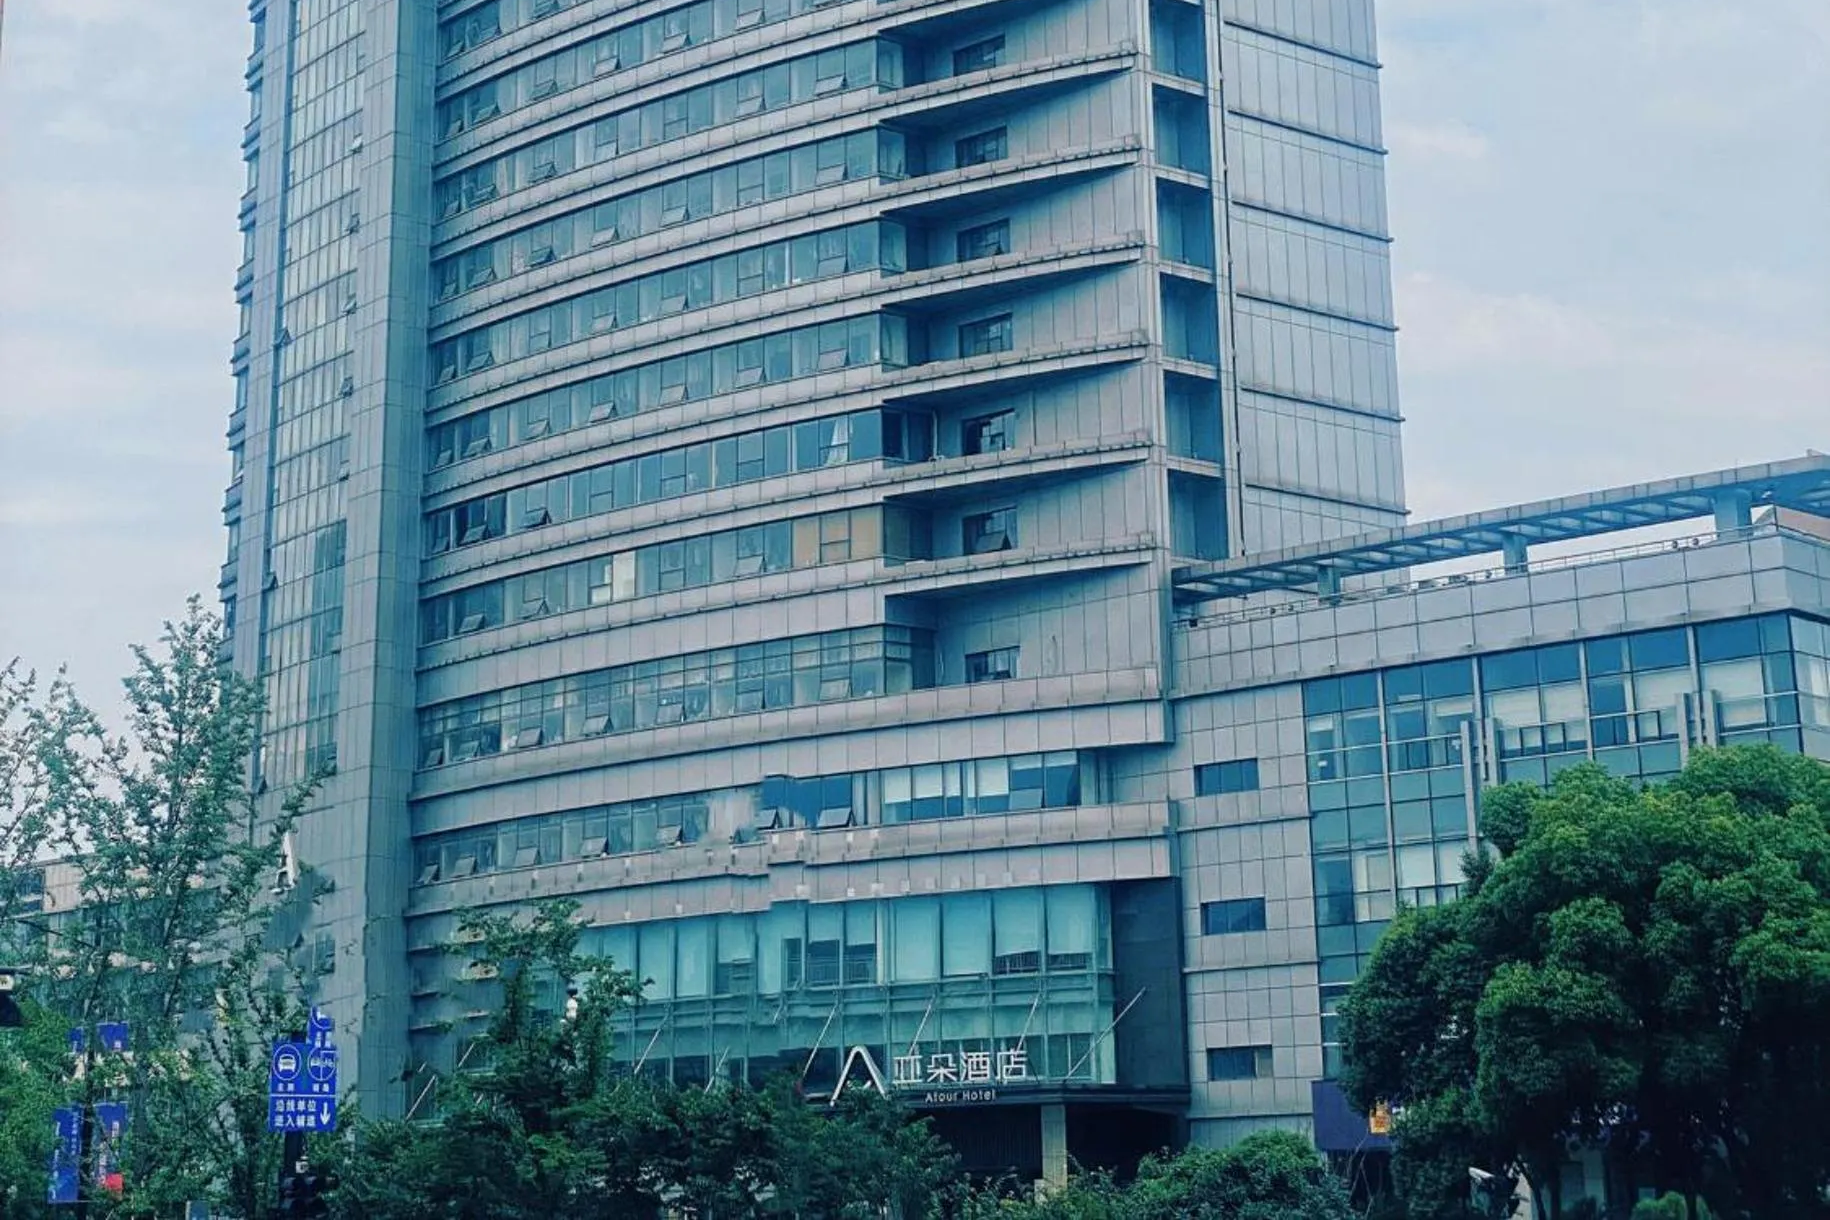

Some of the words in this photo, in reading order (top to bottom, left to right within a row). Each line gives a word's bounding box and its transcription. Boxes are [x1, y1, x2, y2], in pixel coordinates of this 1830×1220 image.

[892, 1049, 1028, 1084] 亚朵酒店
[962, 1089, 996, 1101] Hotel
